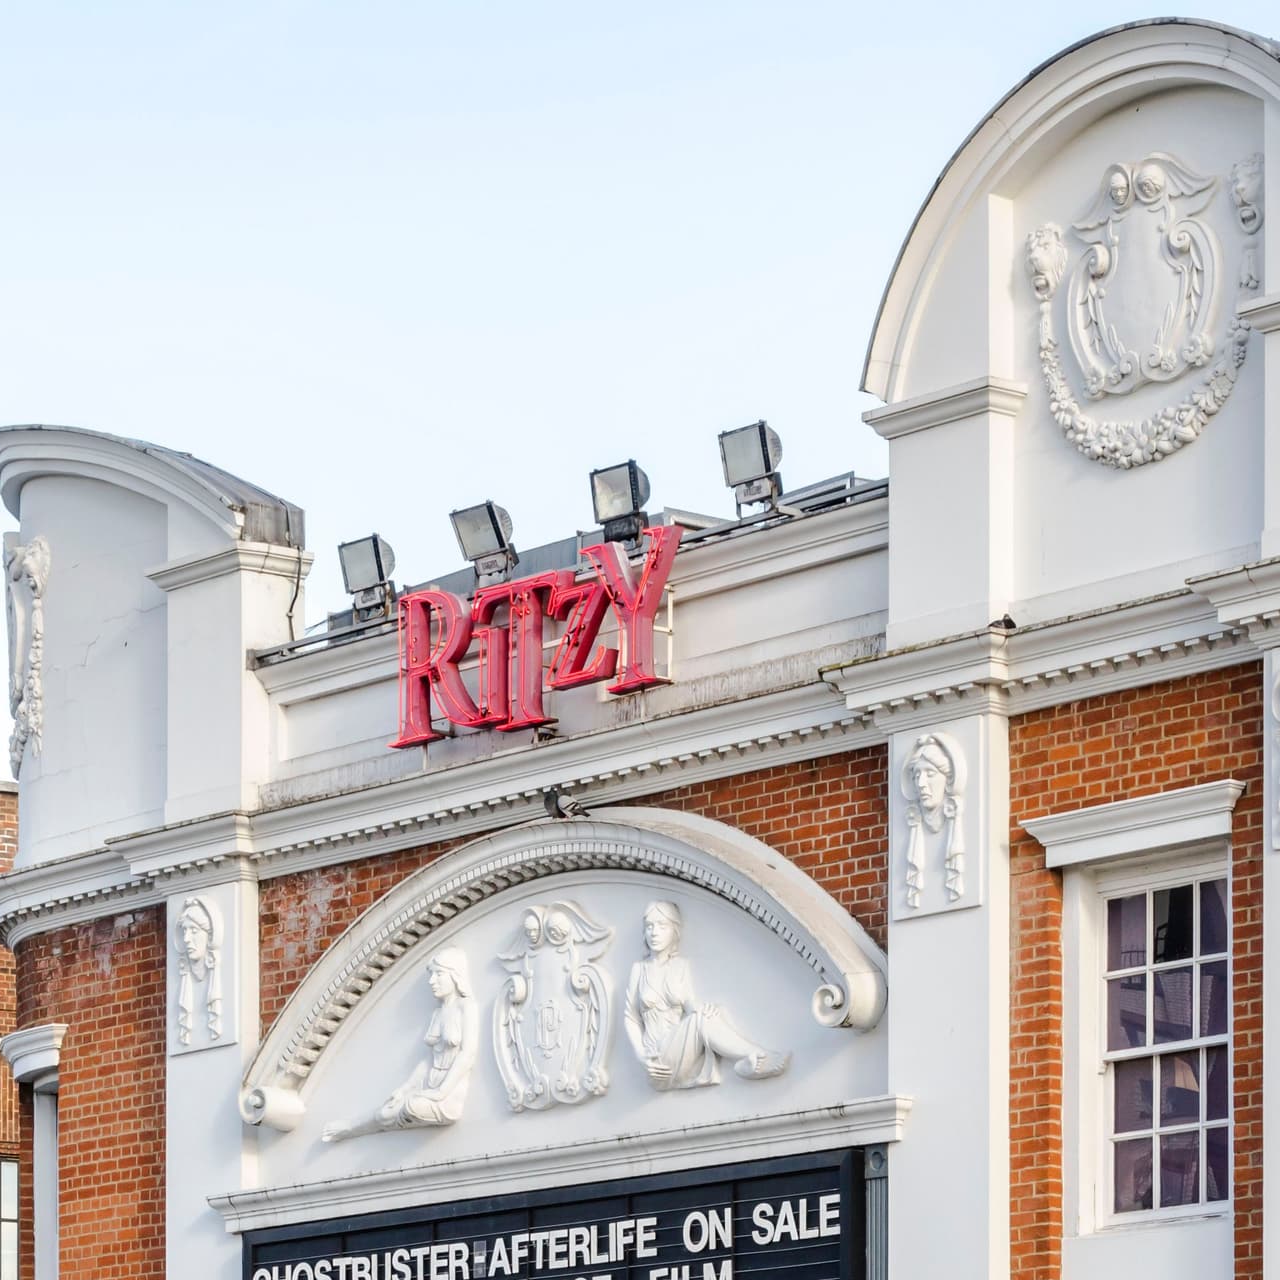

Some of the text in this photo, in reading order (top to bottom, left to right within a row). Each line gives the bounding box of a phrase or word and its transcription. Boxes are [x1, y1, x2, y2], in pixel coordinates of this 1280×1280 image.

[388, 525, 685, 749] RITZY
[682, 1208, 732, 1254] ON
[751, 1194, 841, 1245] SALE
